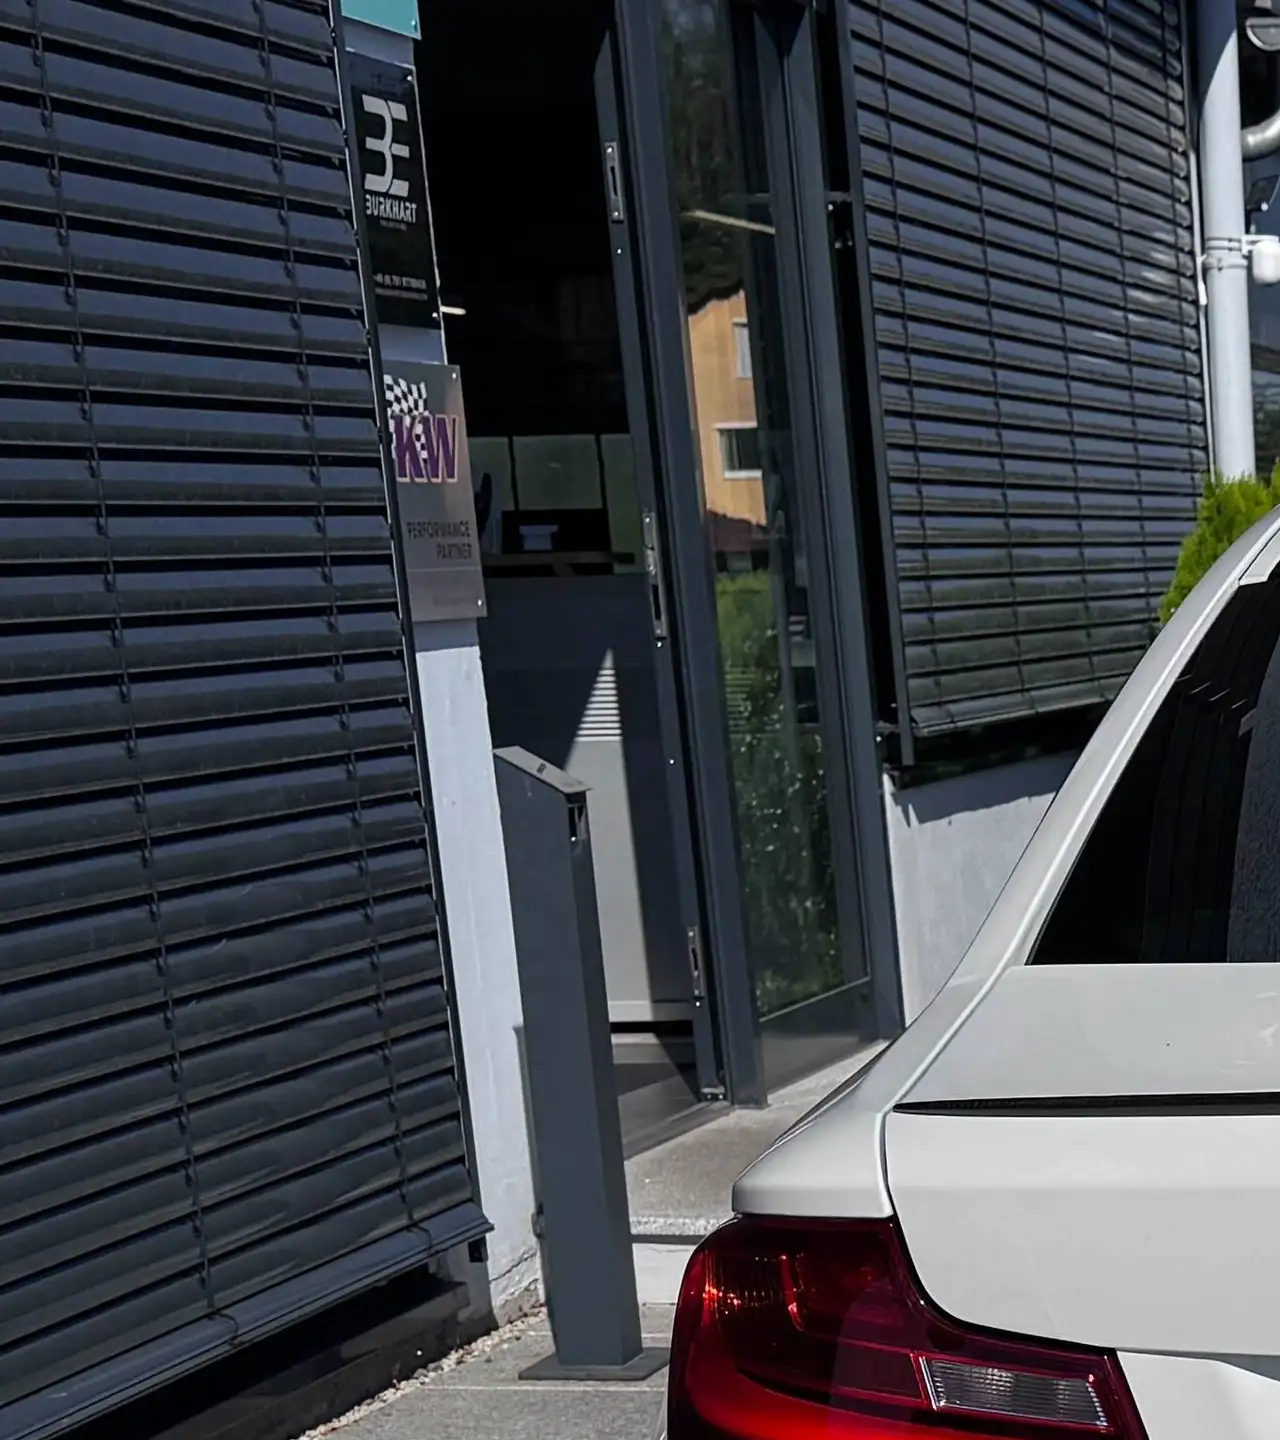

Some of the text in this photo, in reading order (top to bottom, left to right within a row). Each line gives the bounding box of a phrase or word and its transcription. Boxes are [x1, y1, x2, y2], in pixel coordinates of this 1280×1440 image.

[365, 194, 418, 224] BURKHART
[394, 414, 460, 483] KW
[406, 519, 471, 540] PERFORMANCE
[436, 543, 473, 561] PARTNER
